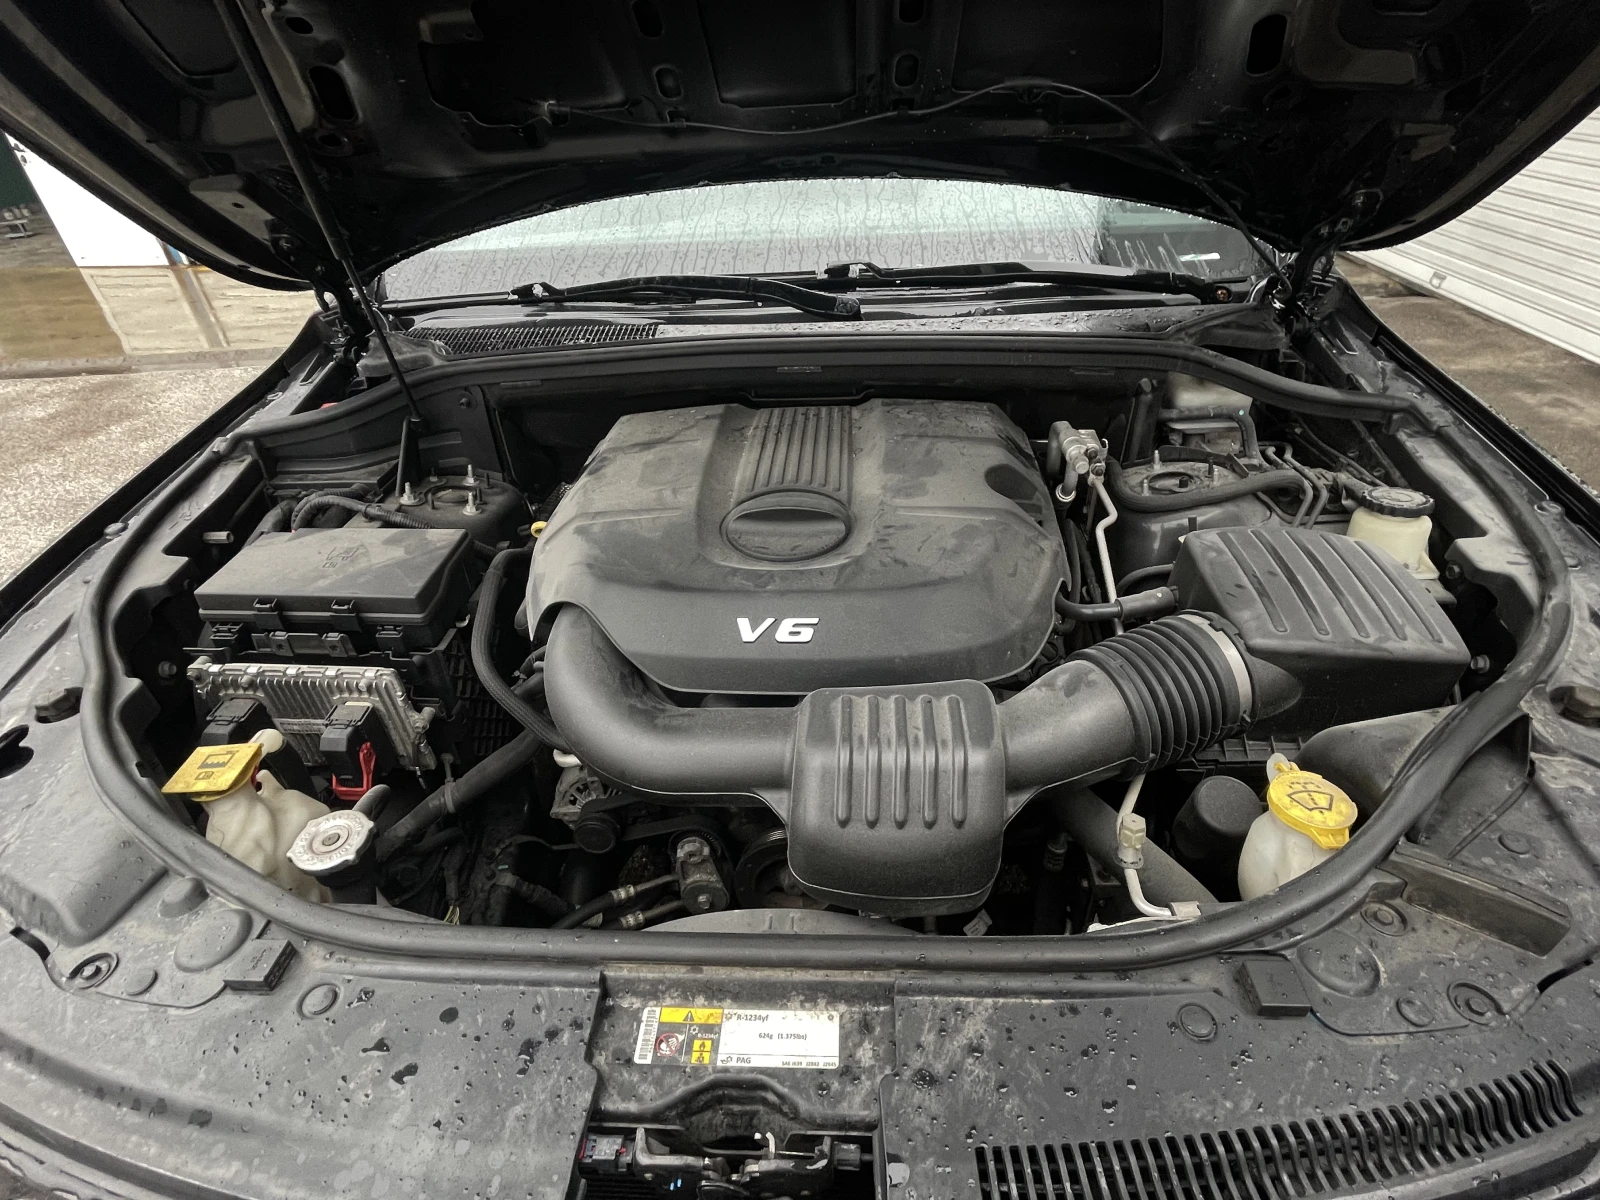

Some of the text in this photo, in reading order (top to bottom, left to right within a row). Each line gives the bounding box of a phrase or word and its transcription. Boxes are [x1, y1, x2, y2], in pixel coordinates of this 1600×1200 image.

[736, 617, 820, 643] V6
[736, 1014, 769, 1023] R-1234yf
[758, 1032, 807, 1041] 624g (1.375lbs)
[736, 1056, 751, 1065] PAG
